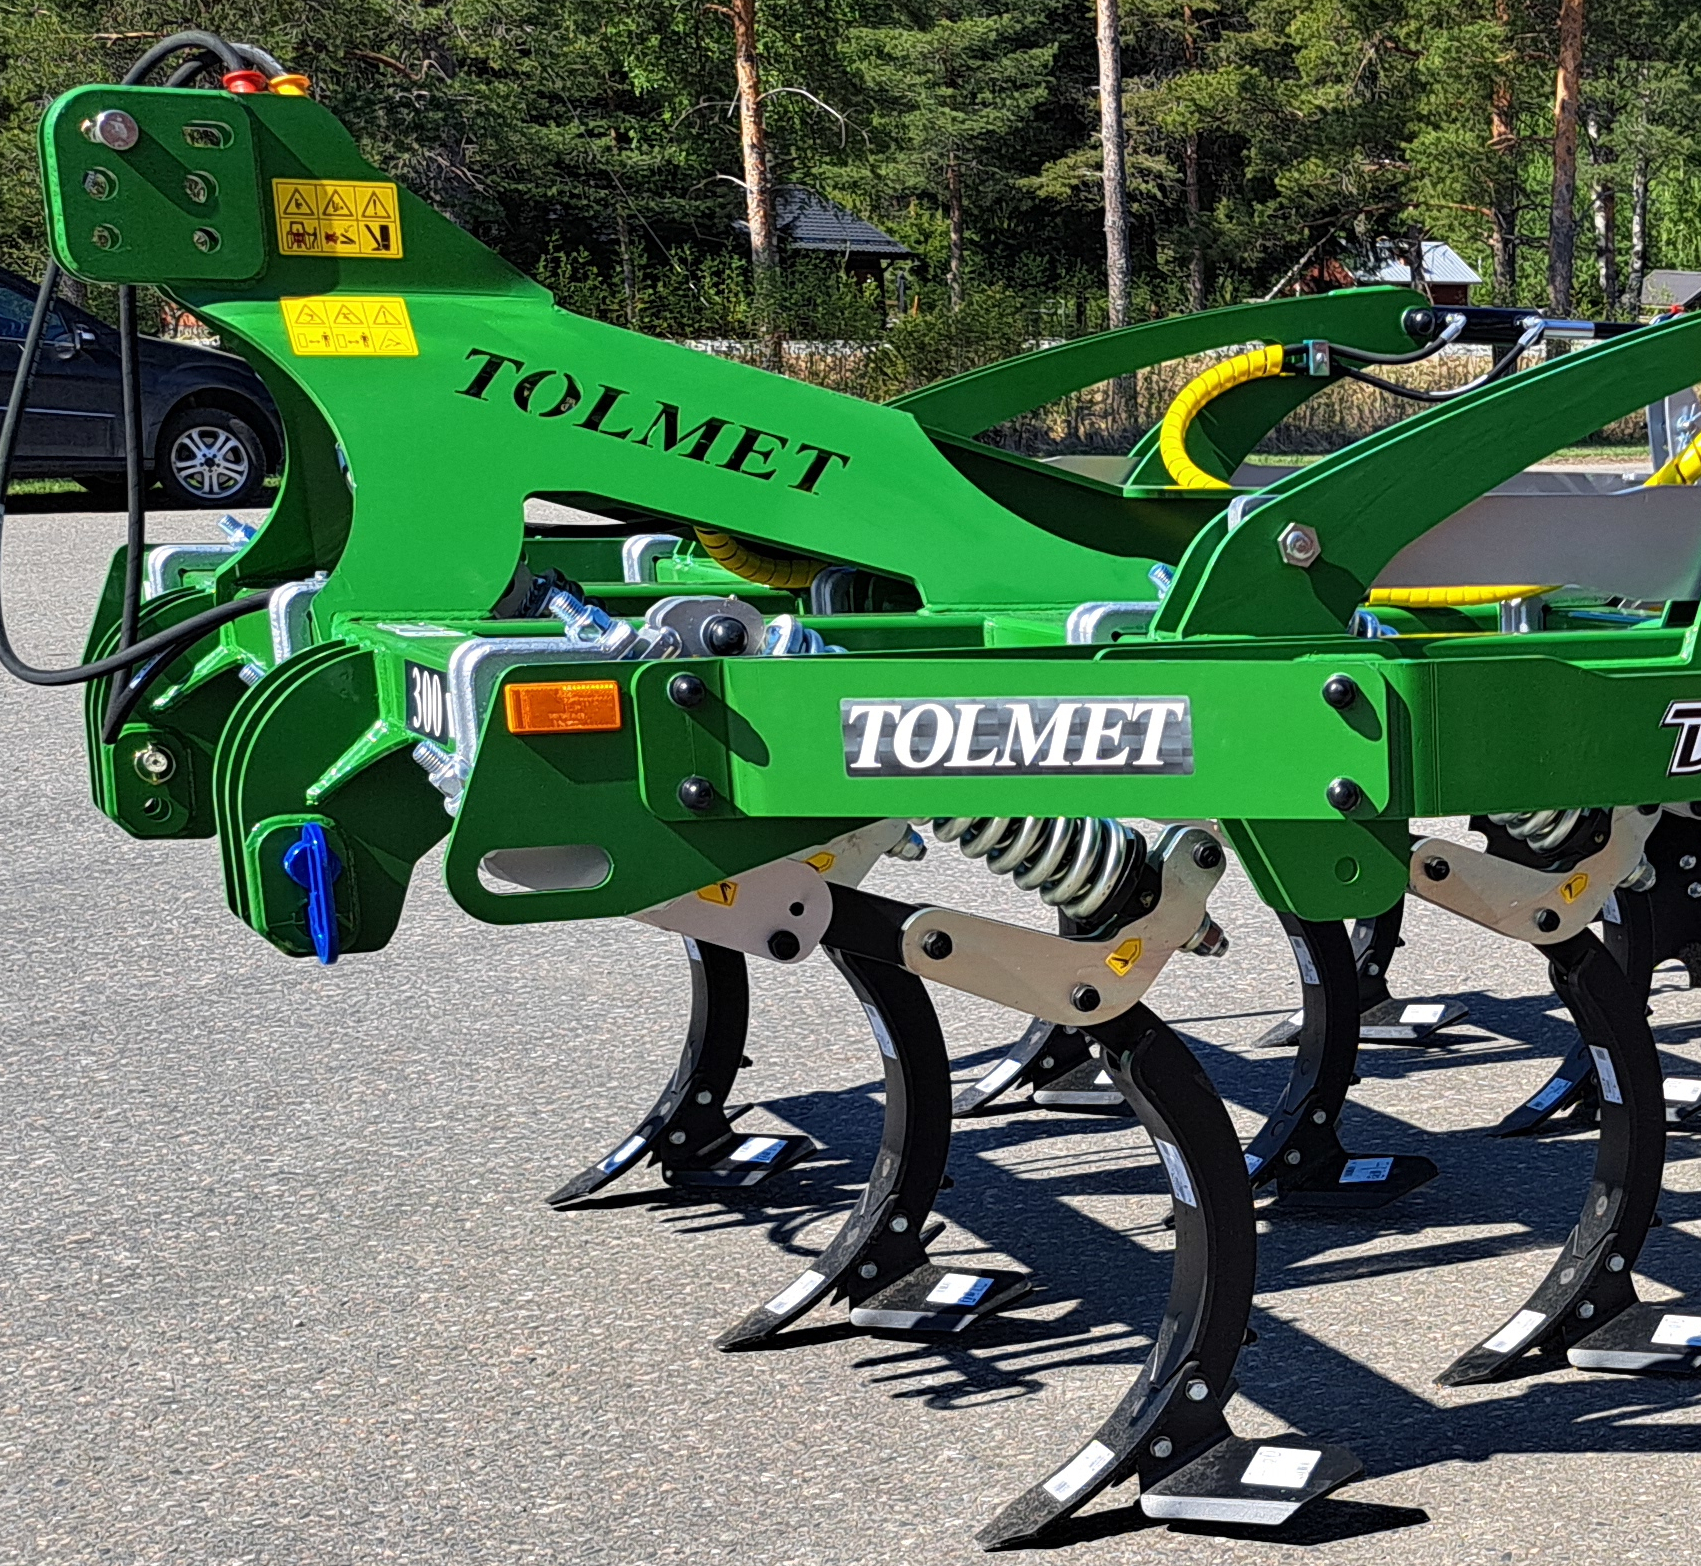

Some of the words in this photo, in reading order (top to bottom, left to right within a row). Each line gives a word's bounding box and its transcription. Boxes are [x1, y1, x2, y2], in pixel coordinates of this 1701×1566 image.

[454, 348, 851, 496] TOLMET
[412, 667, 443, 737] 300
[849, 702, 1185, 769] TOLMET
